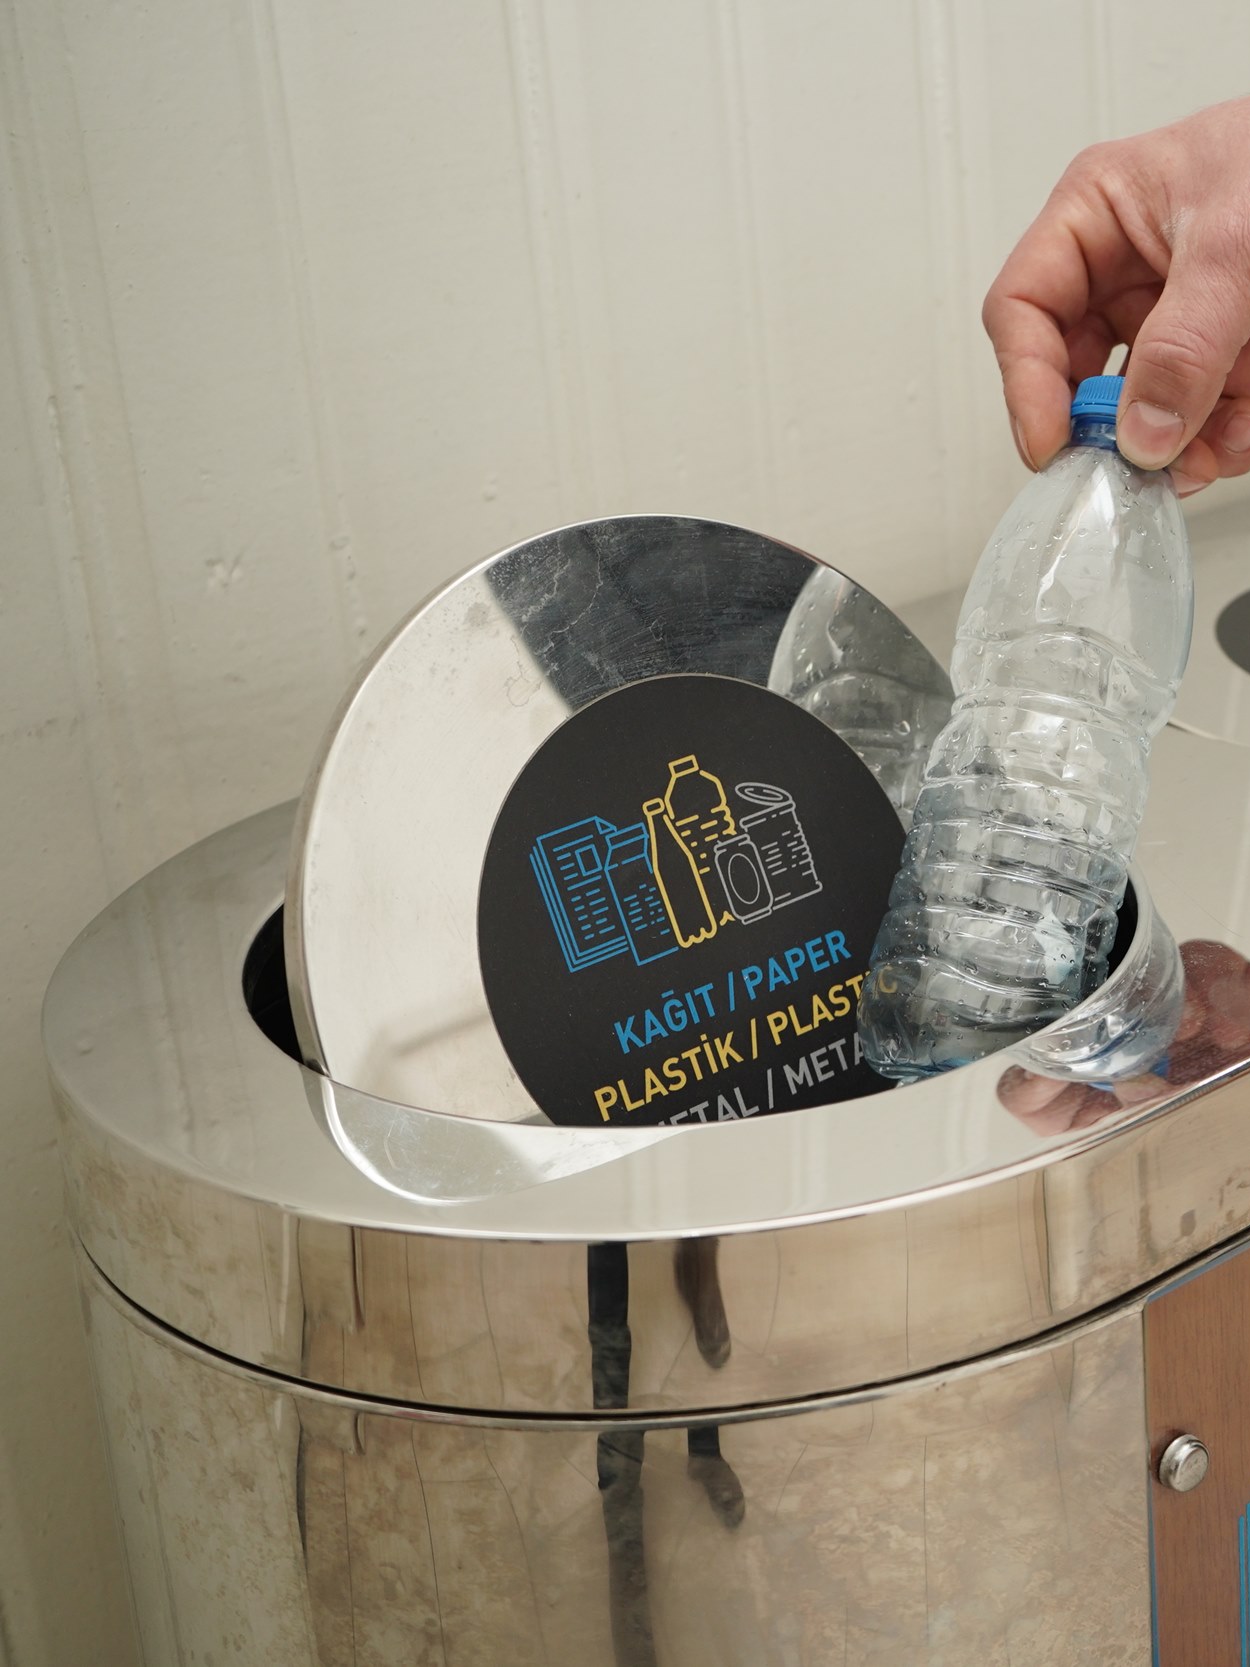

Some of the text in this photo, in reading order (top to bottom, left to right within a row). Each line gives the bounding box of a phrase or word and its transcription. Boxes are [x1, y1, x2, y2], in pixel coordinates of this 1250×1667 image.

[593, 965, 899, 1122] PLASTİK / PLASTC
[613, 929, 852, 1054] KAĞIT / PAPER
[766, 1068, 775, 1109] /
